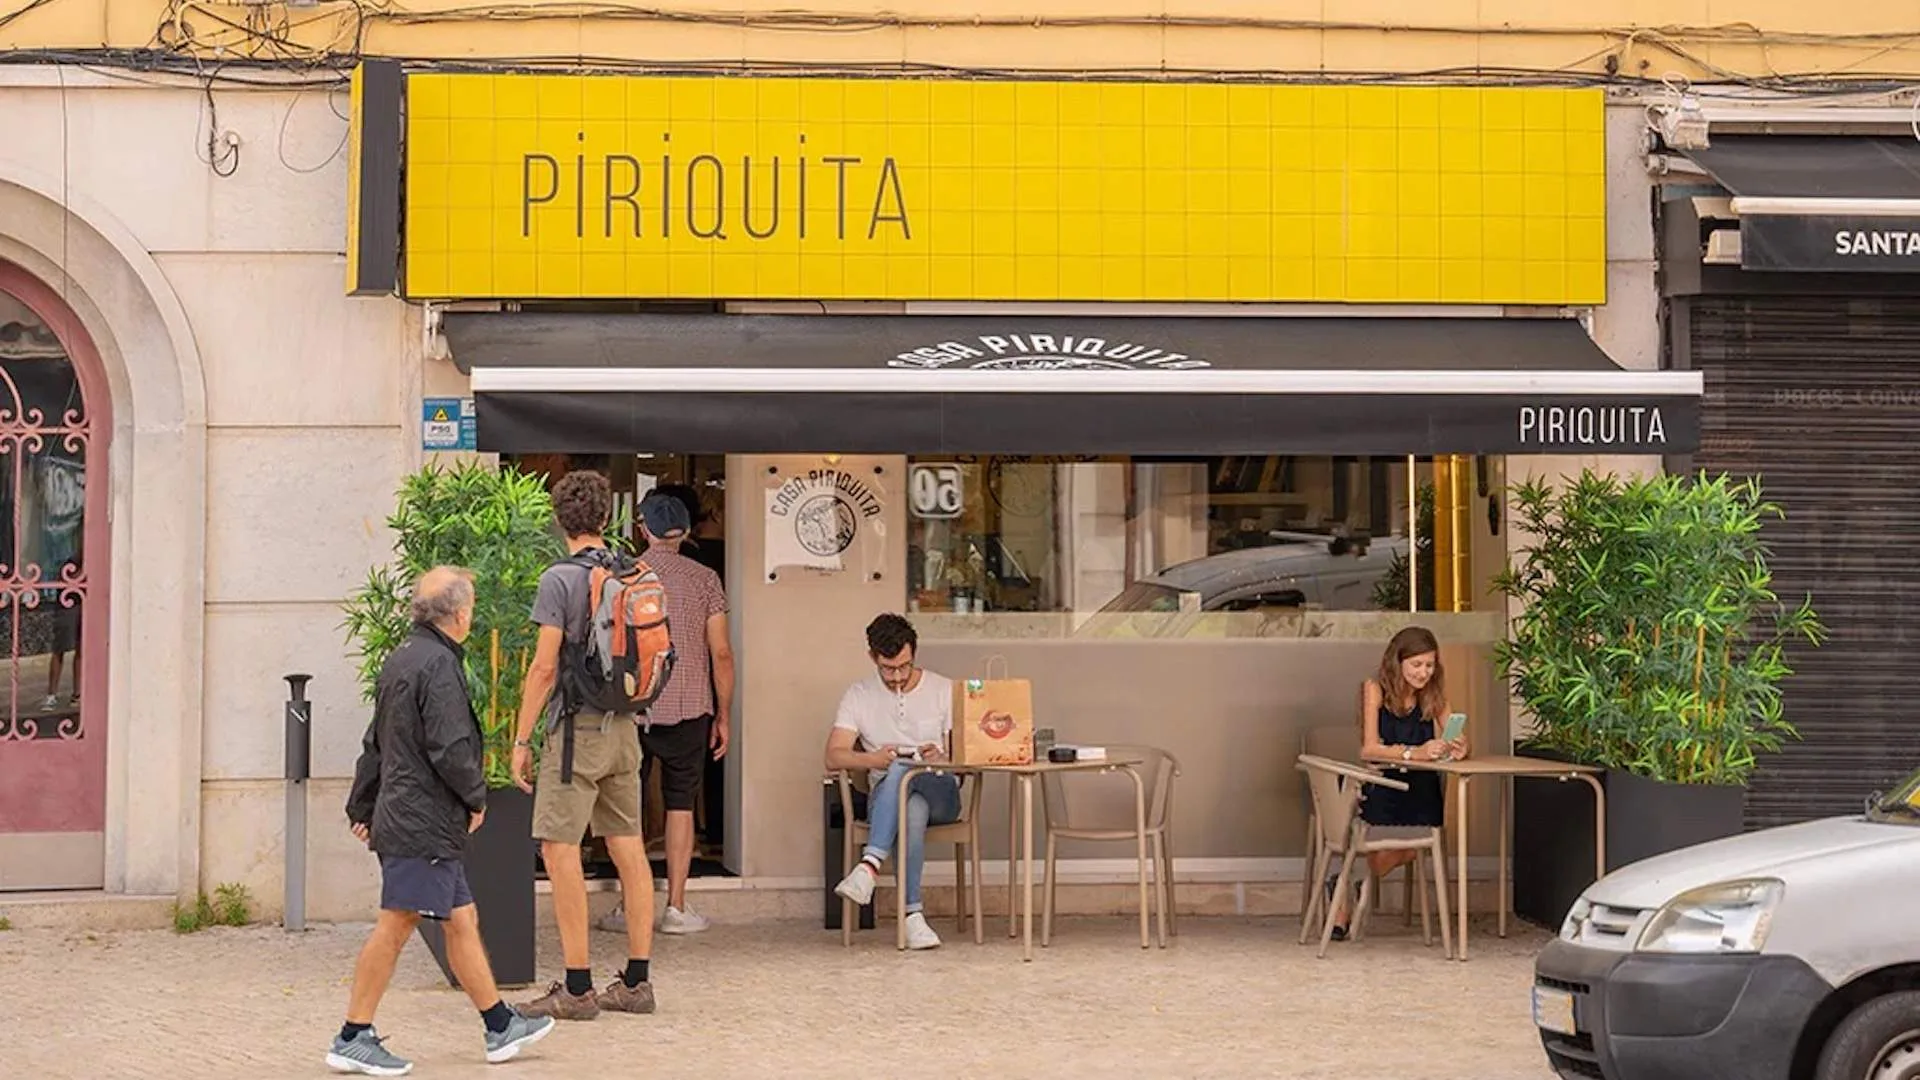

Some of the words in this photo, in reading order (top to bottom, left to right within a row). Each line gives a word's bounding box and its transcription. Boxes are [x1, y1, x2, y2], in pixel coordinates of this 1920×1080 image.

[1835, 230, 1920, 255] SANTA
[978, 333, 1211, 369] PIRIQUITA
[1519, 407, 1666, 443] PIRIQUITA
[771, 477, 807, 517] CASA
[808, 469, 880, 518] PIRIQUITA
